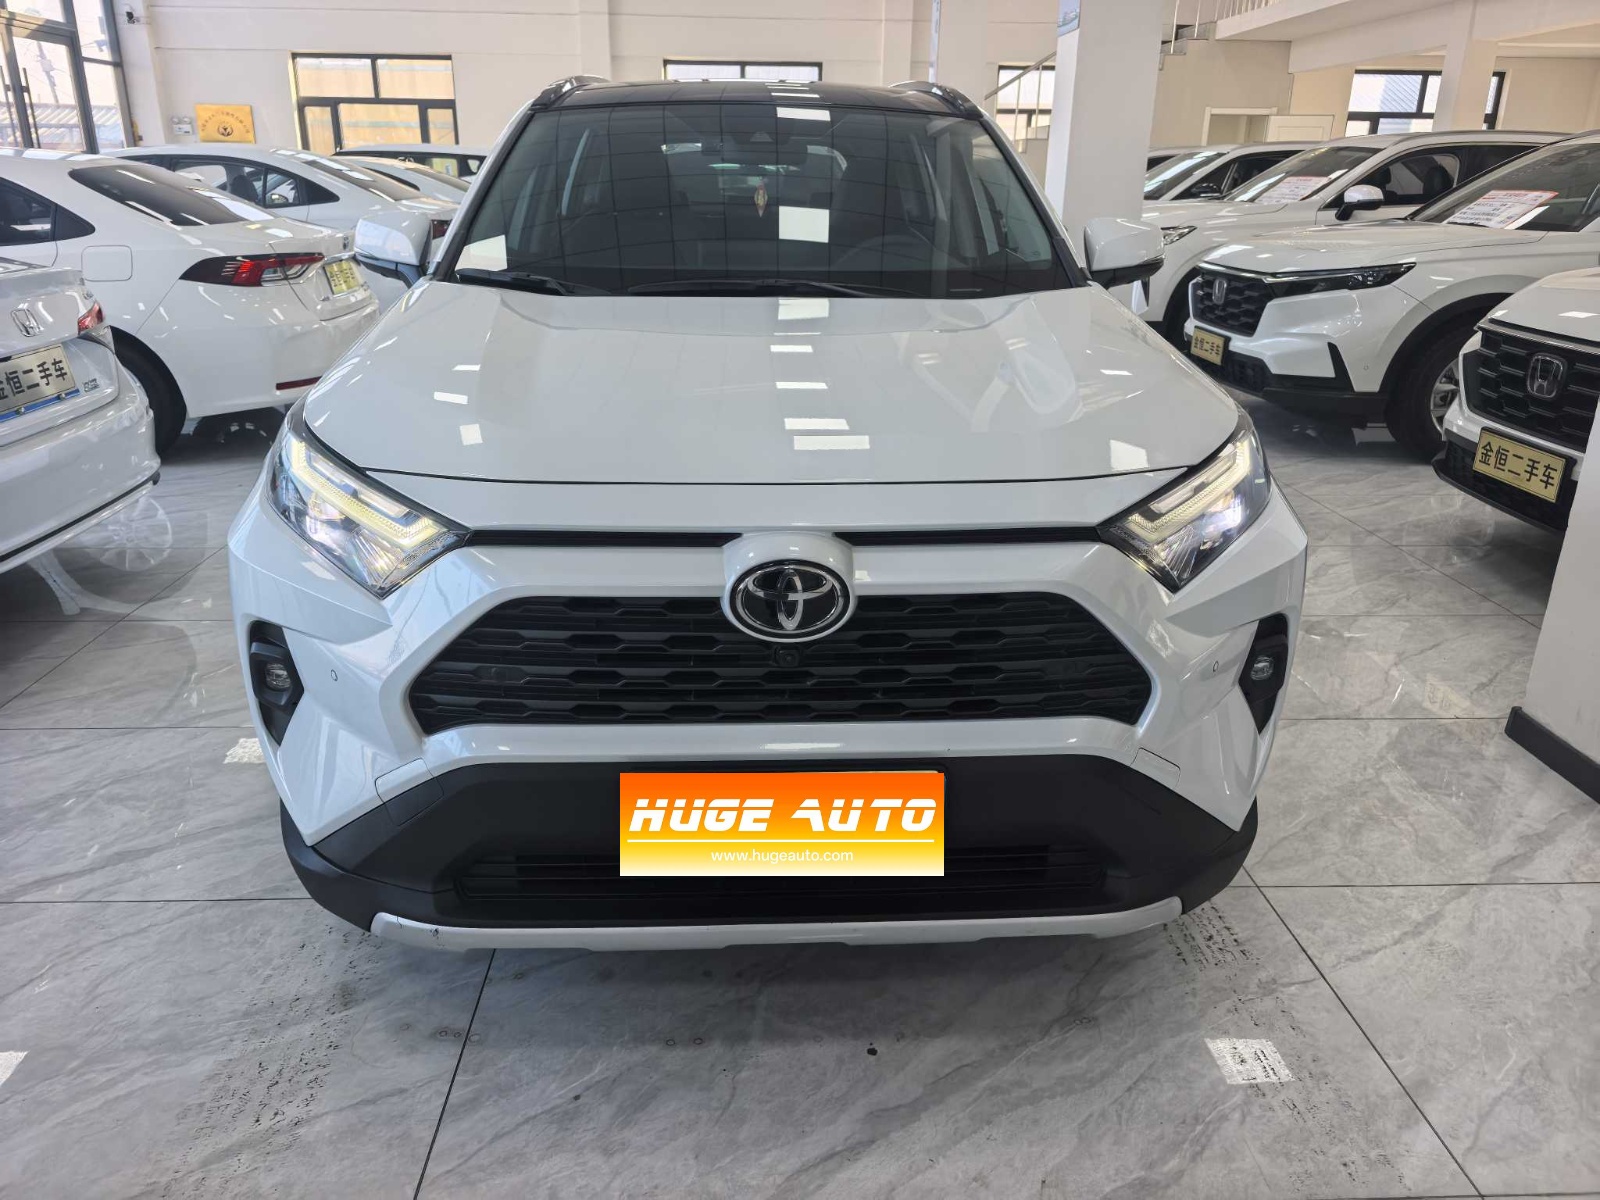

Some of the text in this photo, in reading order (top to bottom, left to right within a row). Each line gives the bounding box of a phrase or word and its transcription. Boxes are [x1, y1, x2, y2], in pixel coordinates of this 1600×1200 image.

[1479, 441, 1558, 490] 金恒二手车
